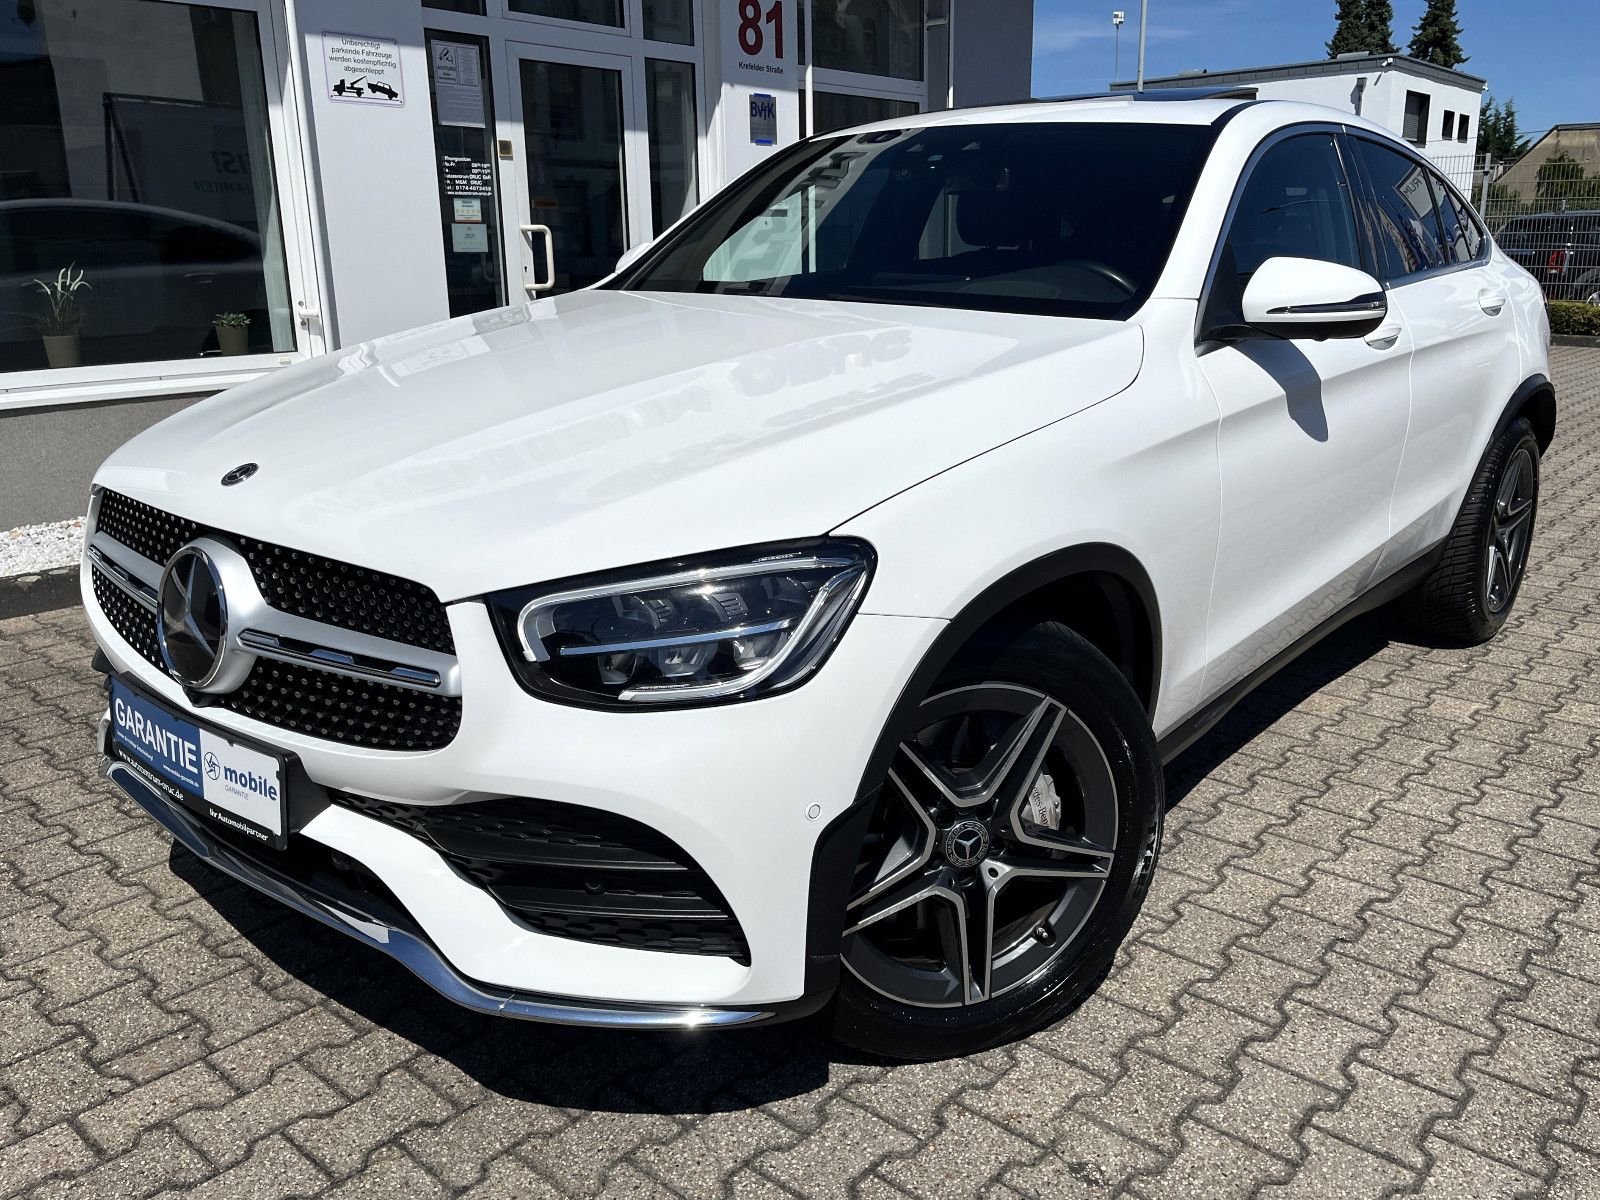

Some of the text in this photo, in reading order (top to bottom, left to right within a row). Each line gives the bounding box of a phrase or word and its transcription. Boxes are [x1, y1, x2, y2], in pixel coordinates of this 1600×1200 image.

[738, 0, 783, 59] 81
[341, 37, 381, 50] Unberechtigt
[331, 47, 393, 60] parkende Fahrzeuge
[328, 55, 397, 69] werden kostenpflichtig
[343, 65, 385, 75] abgeschleppt
[738, 61, 784, 75] Krefelder Straße
[750, 101, 775, 121] BVfK
[115, 698, 198, 774] GARANTIE
[224, 766, 278, 801] mobile
[225, 784, 249, 800] GARANTIE
[209, 807, 269, 841] Ihr Automobilpartner
